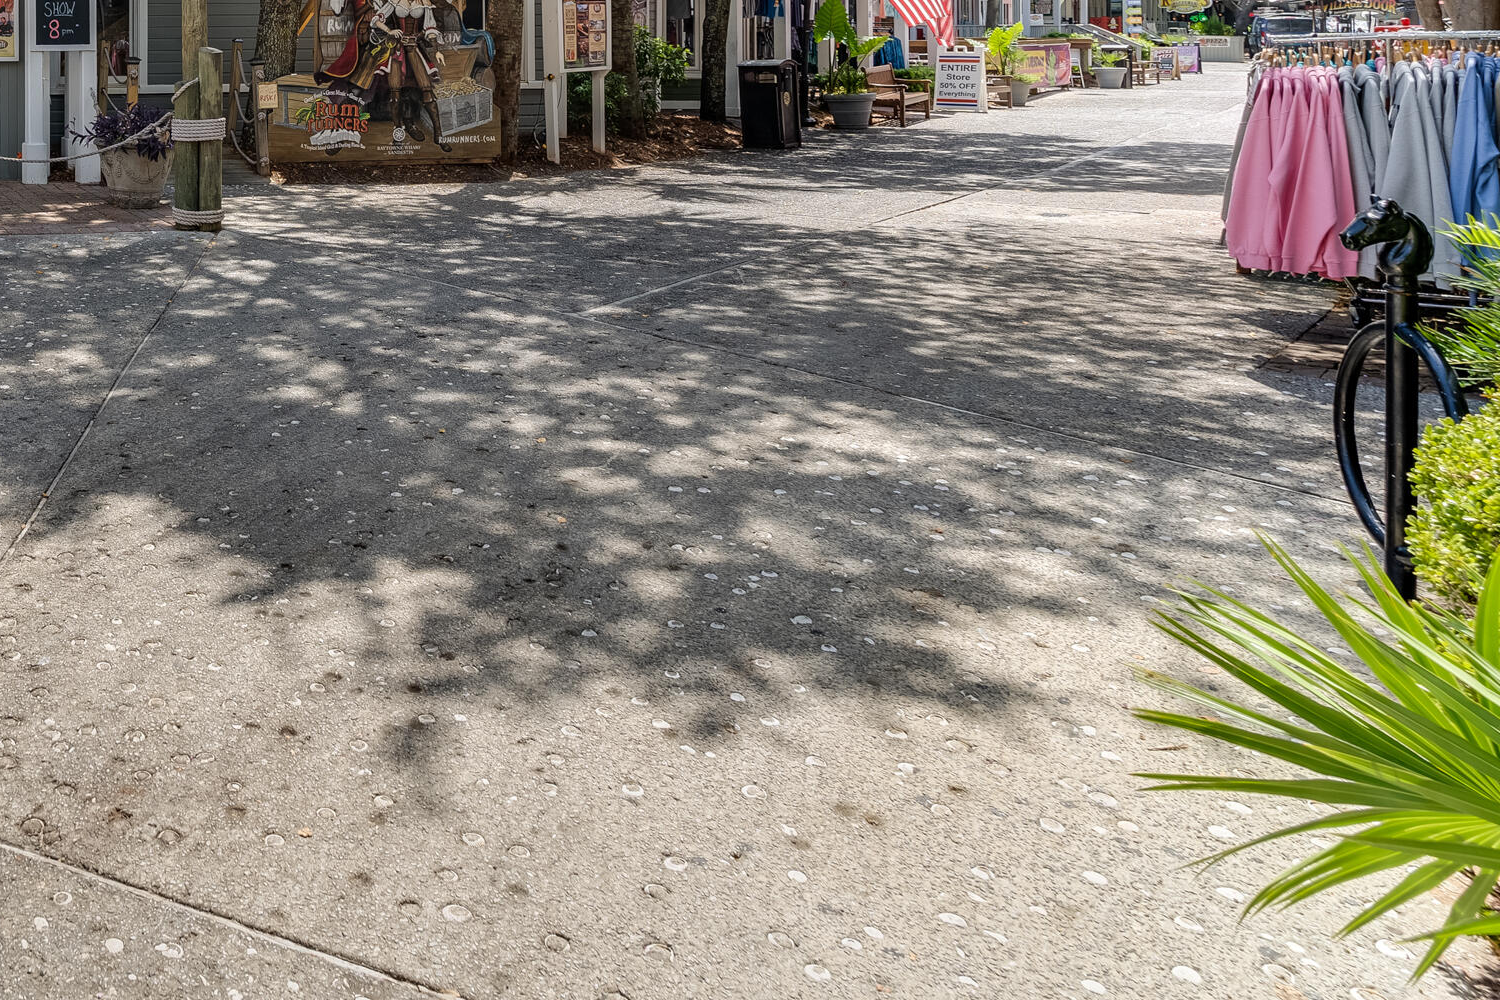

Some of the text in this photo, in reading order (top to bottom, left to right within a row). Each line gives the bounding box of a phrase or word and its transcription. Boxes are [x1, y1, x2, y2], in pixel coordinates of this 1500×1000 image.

[43, 1, 76, 17] SHOW
[48, 19, 74, 39] 8 pm
[940, 64, 978, 72] ENTIRE
[946, 73, 971, 81] Store
[958, 82, 977, 90] OFF
[938, 90, 976, 98] Everything
[315, 101, 360, 117] Rum
